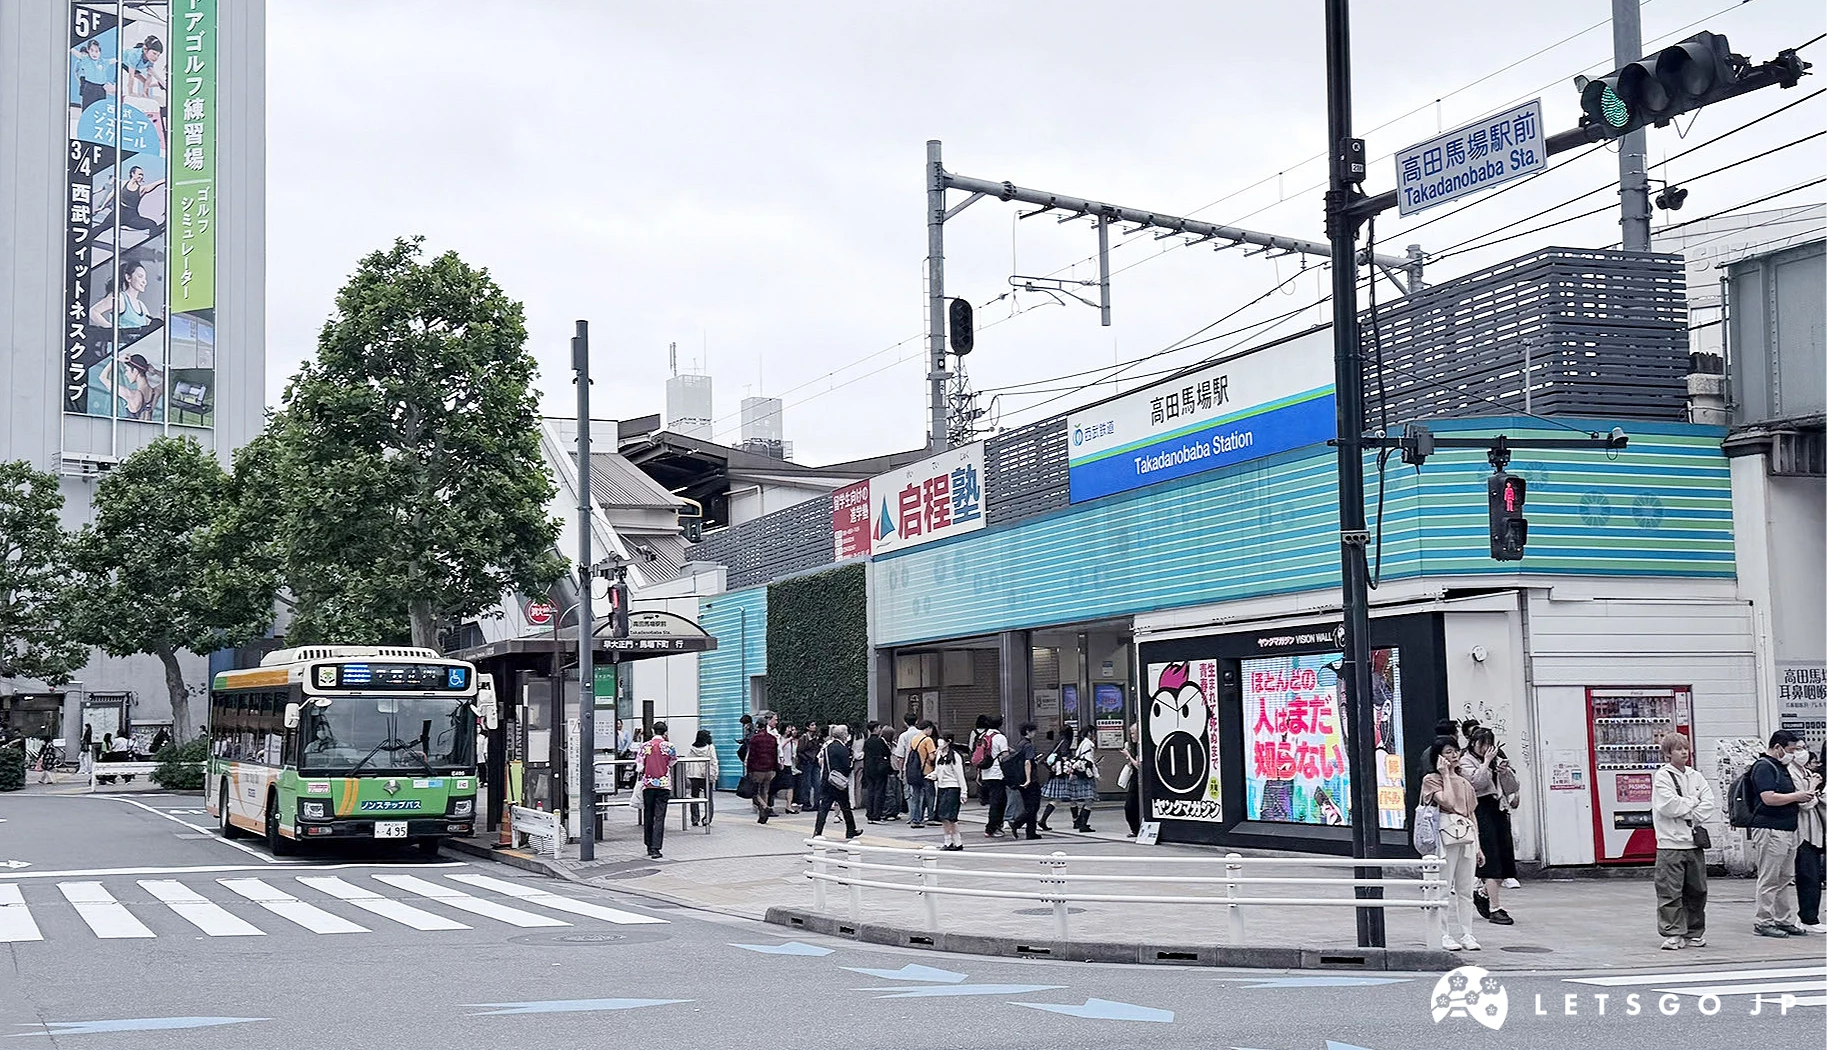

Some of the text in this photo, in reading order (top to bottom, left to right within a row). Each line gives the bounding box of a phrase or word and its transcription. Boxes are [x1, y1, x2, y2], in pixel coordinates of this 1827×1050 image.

[75, 8, 101, 37] 5F
[106, 104, 133, 119] 西武
[71, 141, 102, 177] 3/4F
[1402, 111, 1536, 186] 高田馬場駅前
[1405, 147, 1539, 206] Takadanobaba Sta.
[197, 186, 211, 234] ゴルフ
[180, 197, 196, 300] シミュレーター
[68, 183, 92, 401] 西武フィットネスクラブ
[1150, 375, 1229, 426] 高田馬場駅
[1084, 420, 1115, 442] 西武鉄道
[1134, 431, 1253, 476] Takadanobaba Station
[675, 640, 684, 649] 行
[1295, 634, 1316, 645] VISION
[1316, 632, 1333, 644] WALL
[1251, 668, 1317, 694] ほとんどの
[1253, 695, 1333, 737] 人はまだ
[1253, 741, 1346, 781] 知らない
[361, 800, 422, 811] ノンステップバス
[1153, 798, 1221, 819] ヤングマガジン
